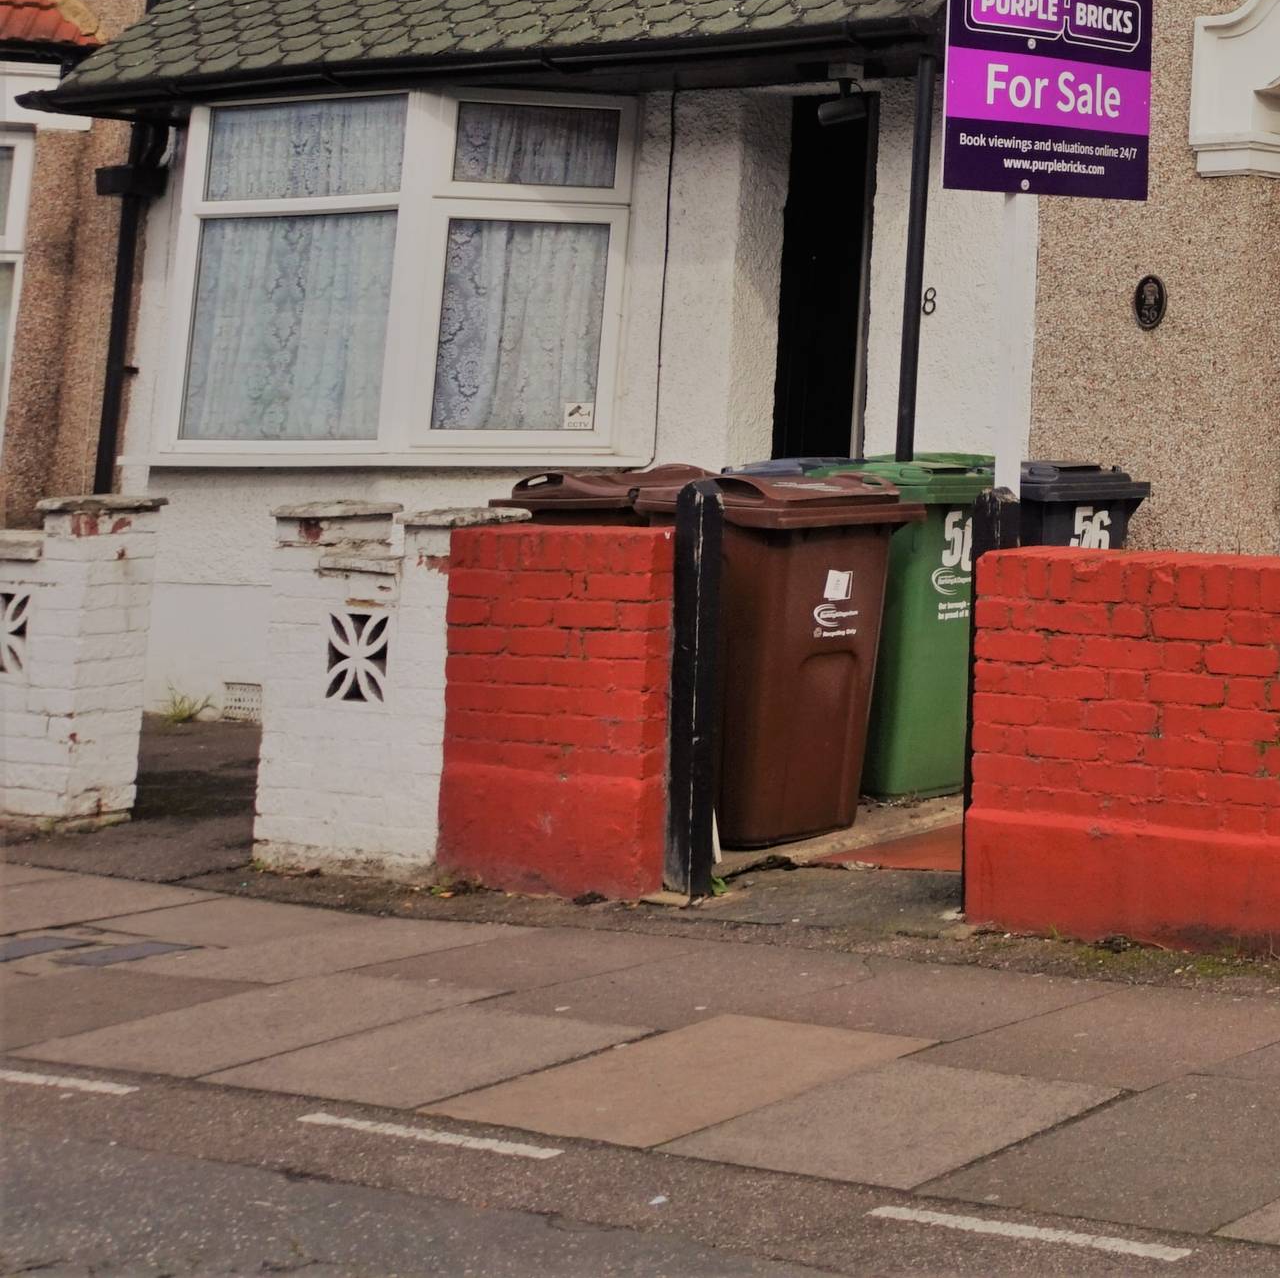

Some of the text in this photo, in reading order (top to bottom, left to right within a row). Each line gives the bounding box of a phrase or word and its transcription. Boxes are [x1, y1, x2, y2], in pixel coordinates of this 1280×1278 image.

[1075, 2, 1133, 34] BRICKS
[986, 63, 1120, 118] For Sale
[959, 132, 1138, 161] Book viewings and valuations online 24/7
[1003, 157, 1105, 175] www.purplebricks.com
[922, 286, 937, 316] 8
[1069, 506, 1112, 550] 56
